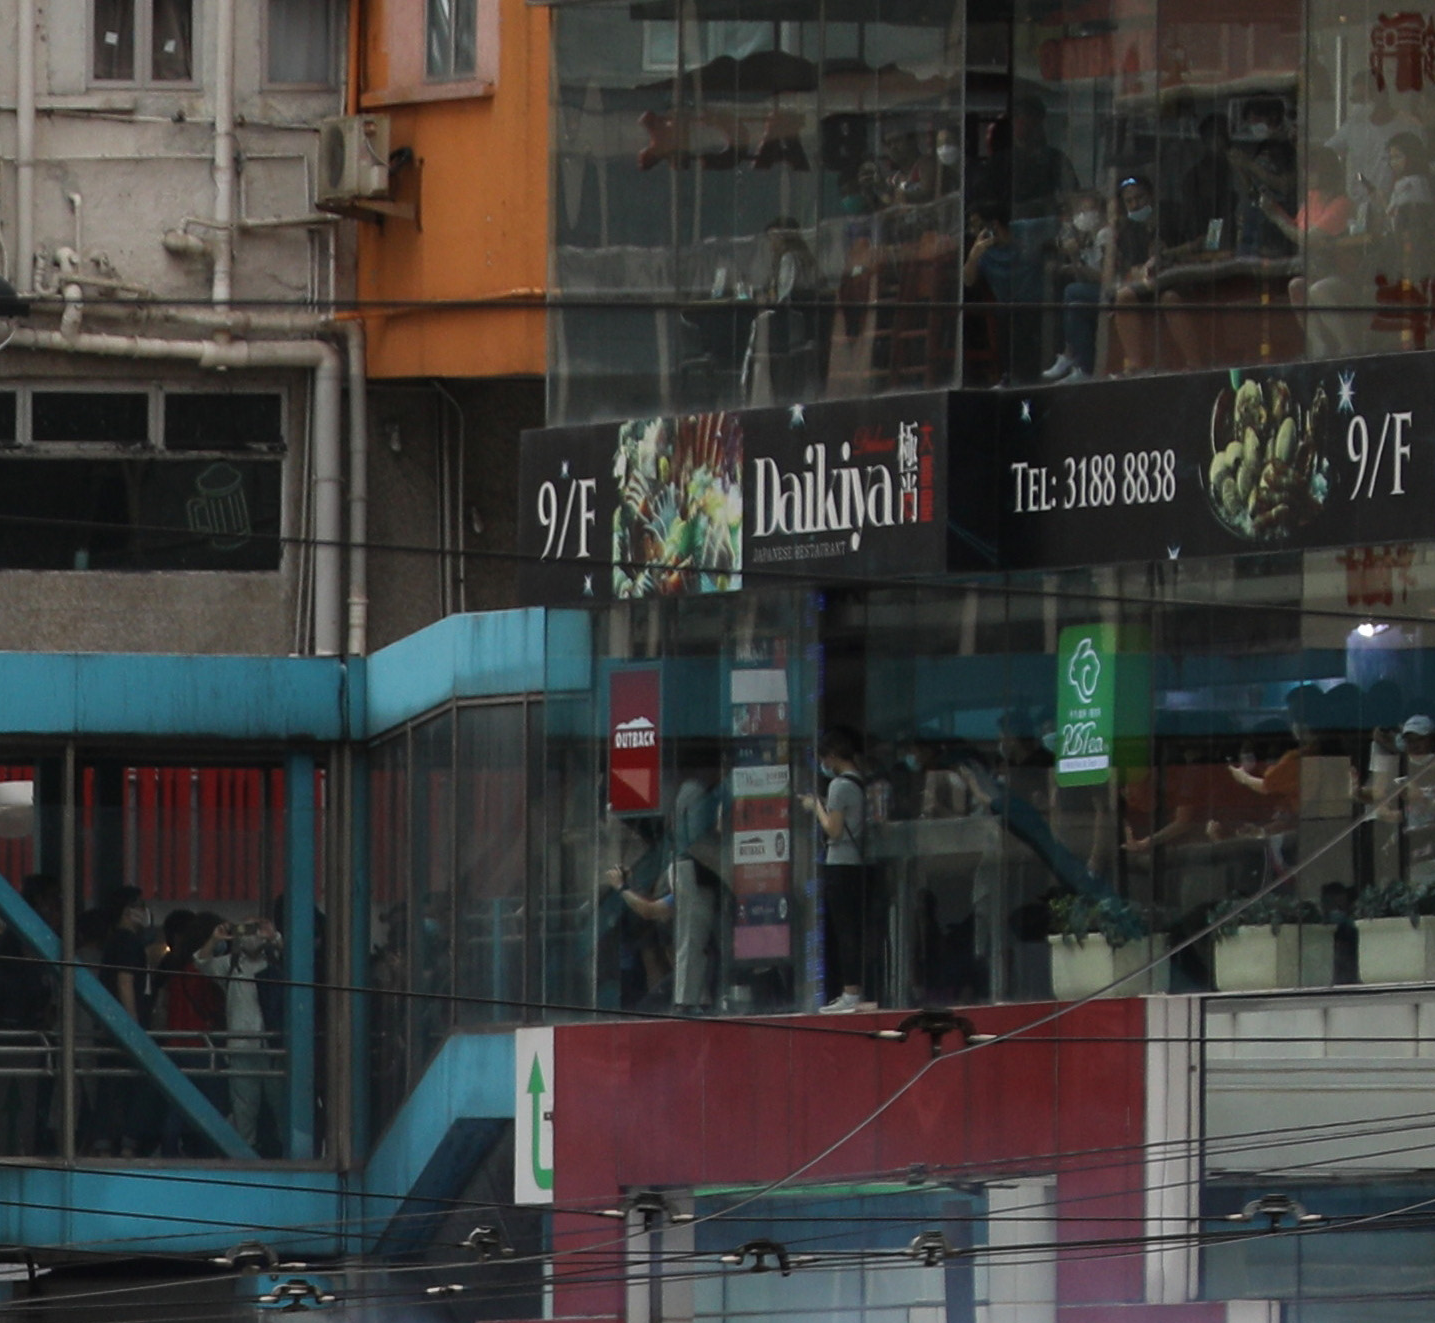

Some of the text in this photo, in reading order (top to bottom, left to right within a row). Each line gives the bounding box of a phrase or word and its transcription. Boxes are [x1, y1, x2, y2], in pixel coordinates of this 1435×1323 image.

[538, 442, 894, 561] 9/F Daikiya
[1064, 453, 1114, 509] 3188
[1123, 449, 1176, 504] 8838
[1348, 411, 1413, 500] 9/F
[615, 730, 655, 748] OUTBACK
